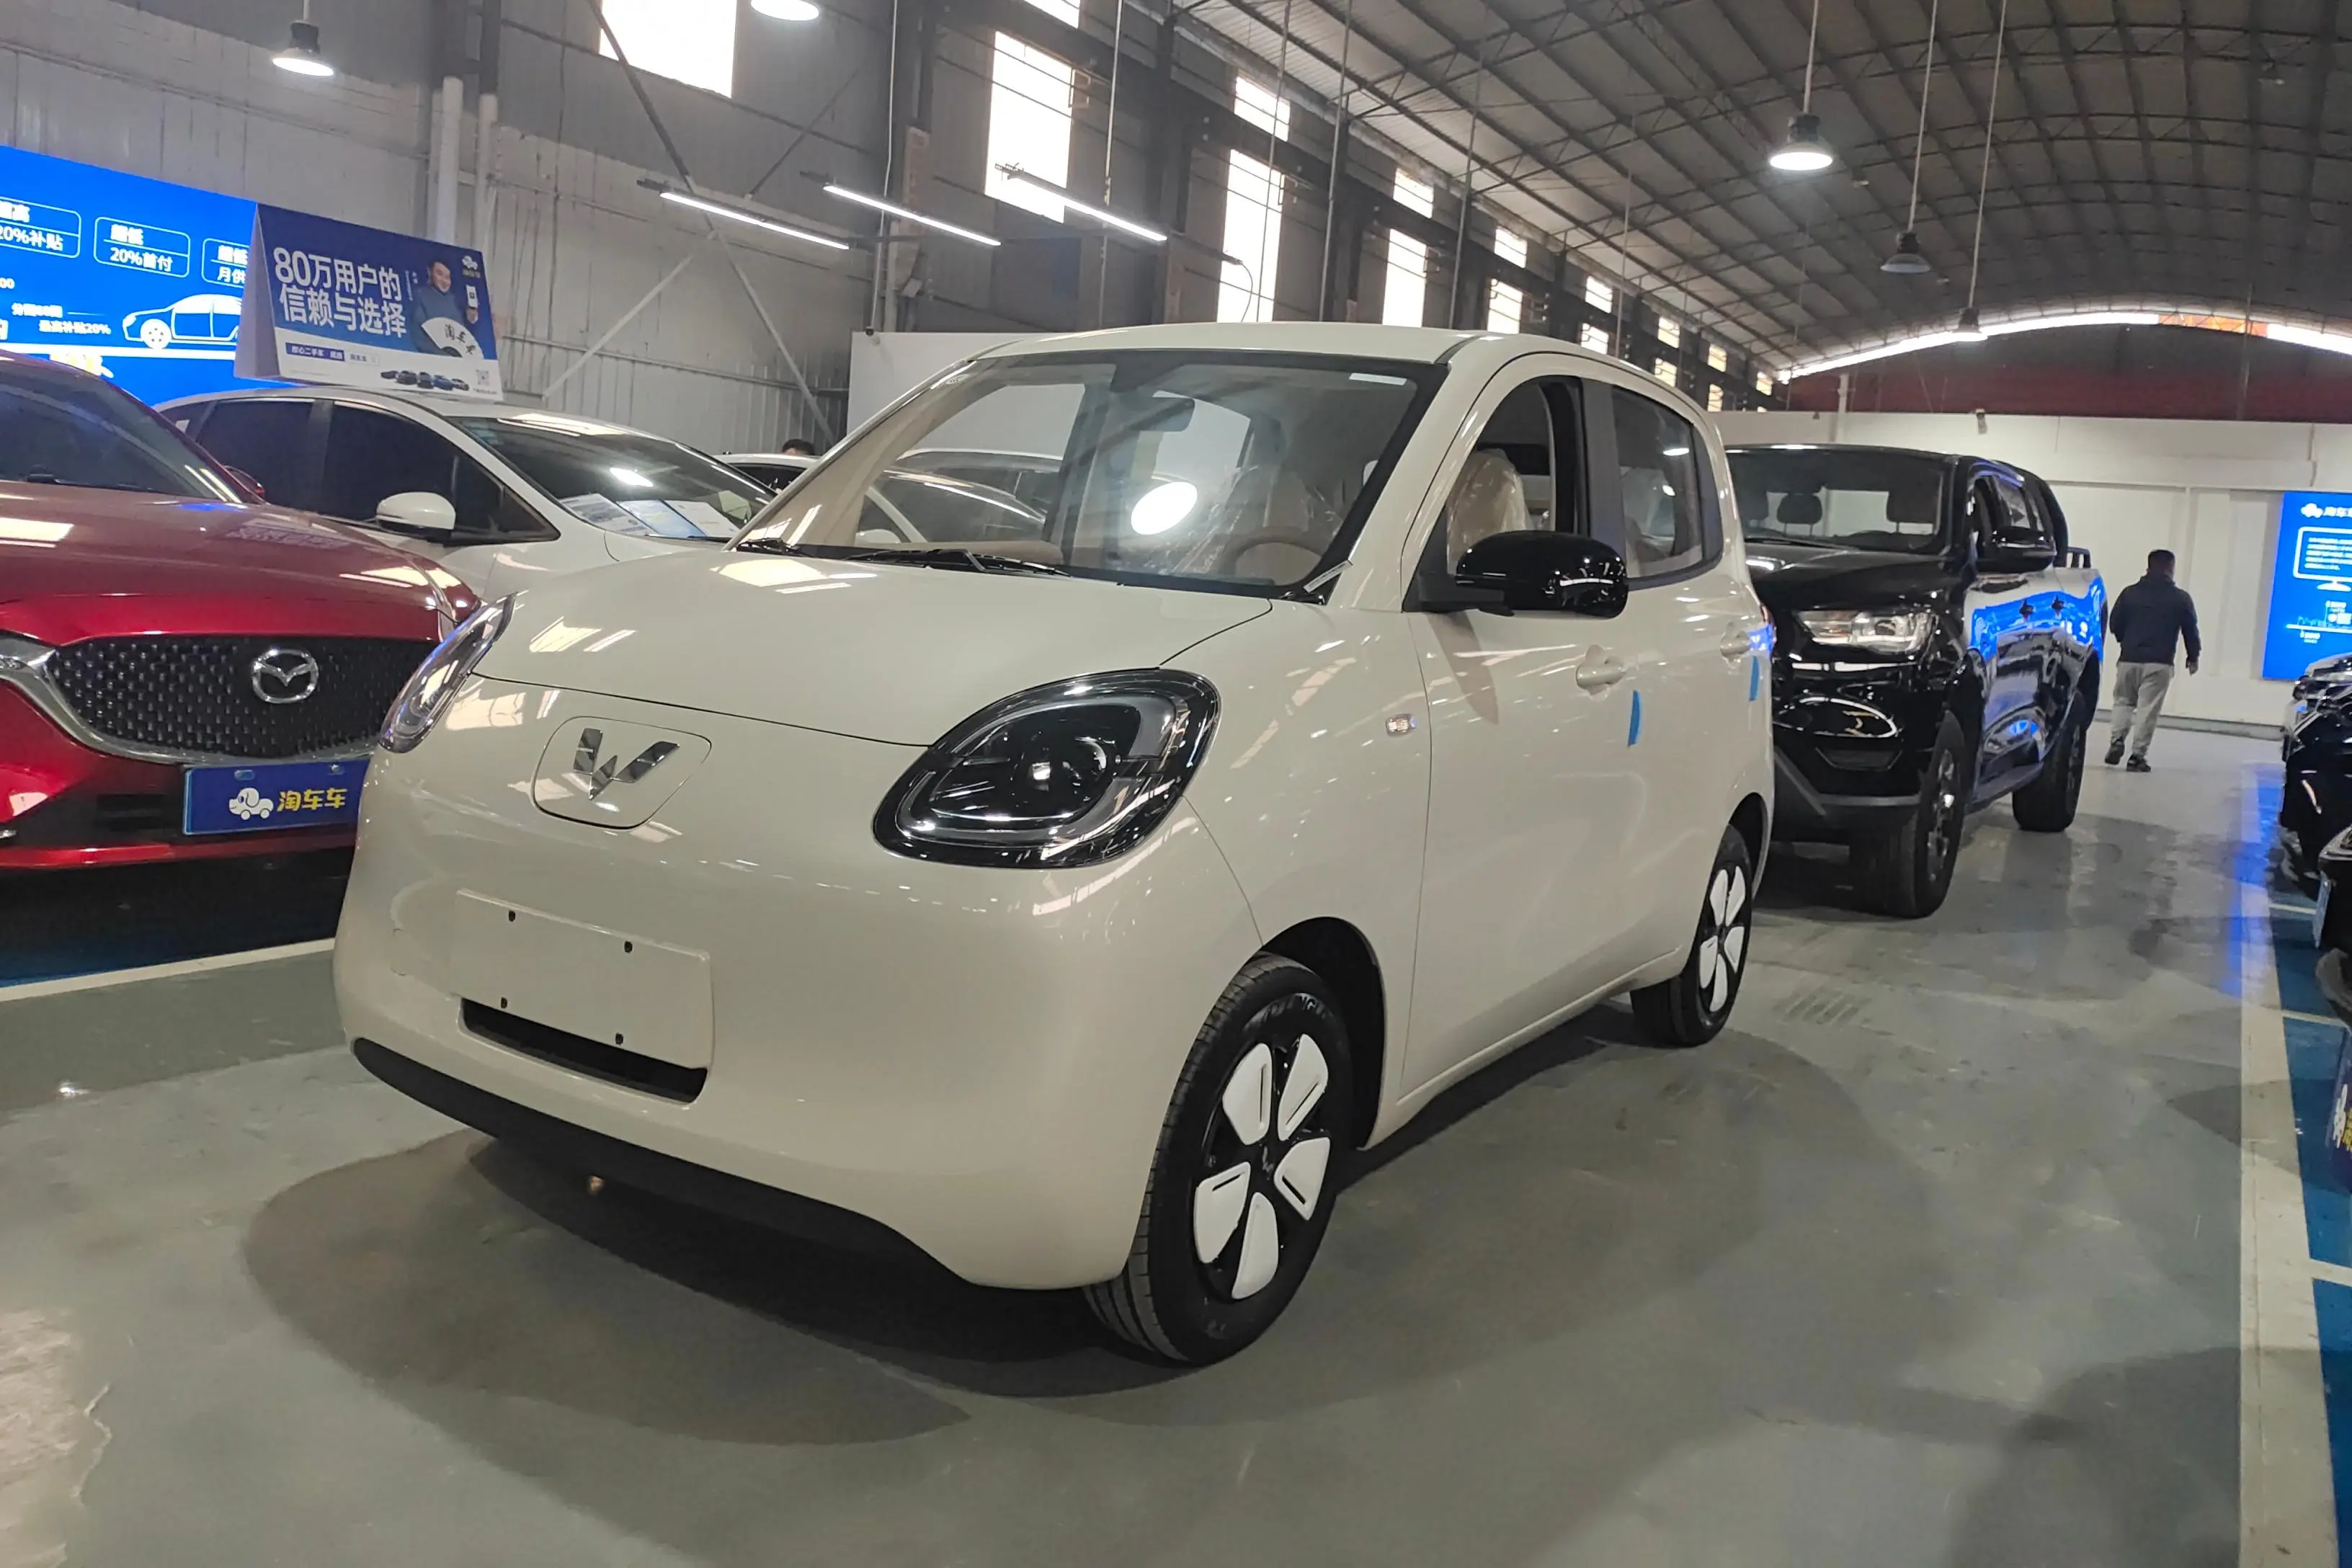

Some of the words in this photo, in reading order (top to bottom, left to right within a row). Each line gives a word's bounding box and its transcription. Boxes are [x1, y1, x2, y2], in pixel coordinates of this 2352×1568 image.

[273, 247, 402, 301] 80万用户的
[279, 283, 407, 338] 信赖与选择
[276, 787, 348, 812] 淘车车
